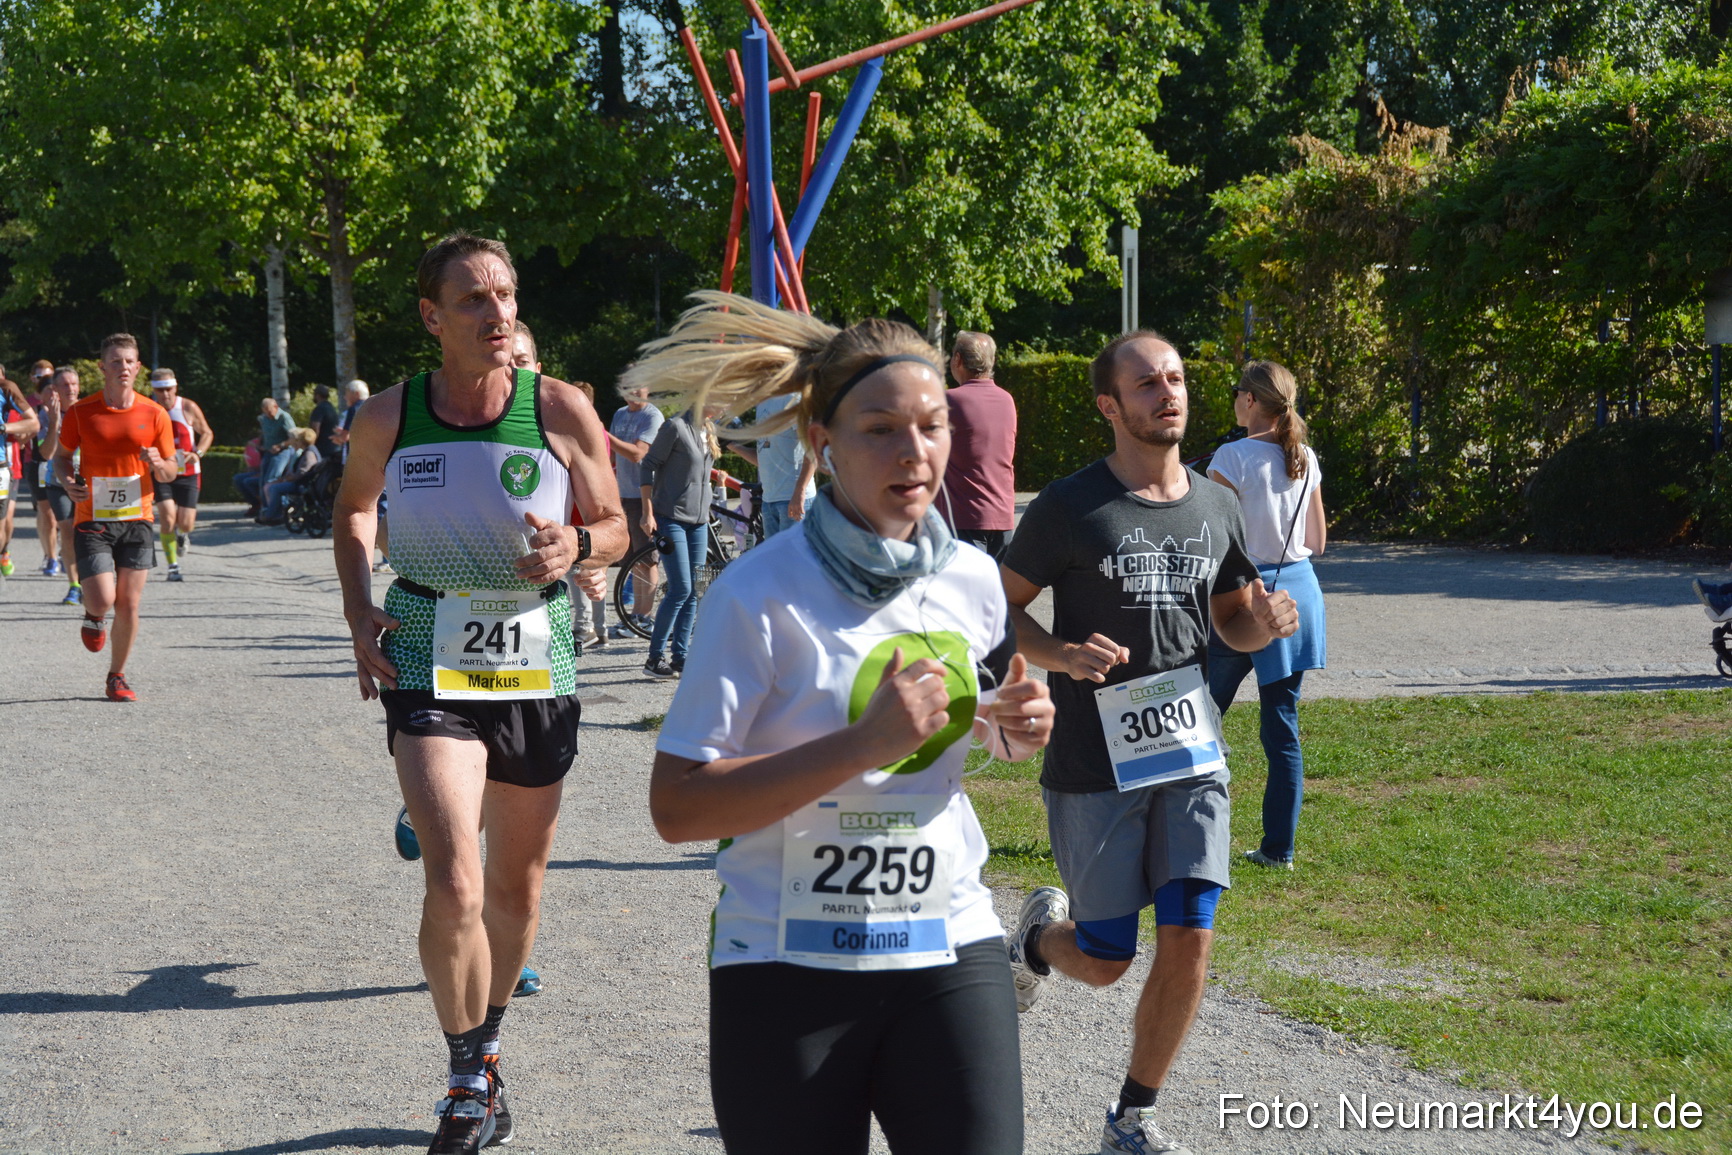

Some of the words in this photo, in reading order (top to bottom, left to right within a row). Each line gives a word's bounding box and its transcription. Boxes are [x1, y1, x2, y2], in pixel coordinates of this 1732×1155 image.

[109, 489, 126, 503] 75
[1123, 554, 1205, 577] CROSSFIT
[471, 600, 519, 612] BOCK
[463, 621, 520, 654] 241
[459, 659, 485, 667] PARTL
[485, 659, 519, 667] Neumarkt
[468, 674, 520, 688] Markus
[1130, 680, 1177, 701] BOCK
[1120, 698, 1197, 744] 3080
[1133, 743, 1158, 754] PARTL
[839, 812, 918, 829] BOCK
[811, 844, 936, 896] 2259
[822, 904, 861, 915] PARTL
[863, 903, 908, 915] Neumarkt
[832, 927, 910, 951] Corinna
